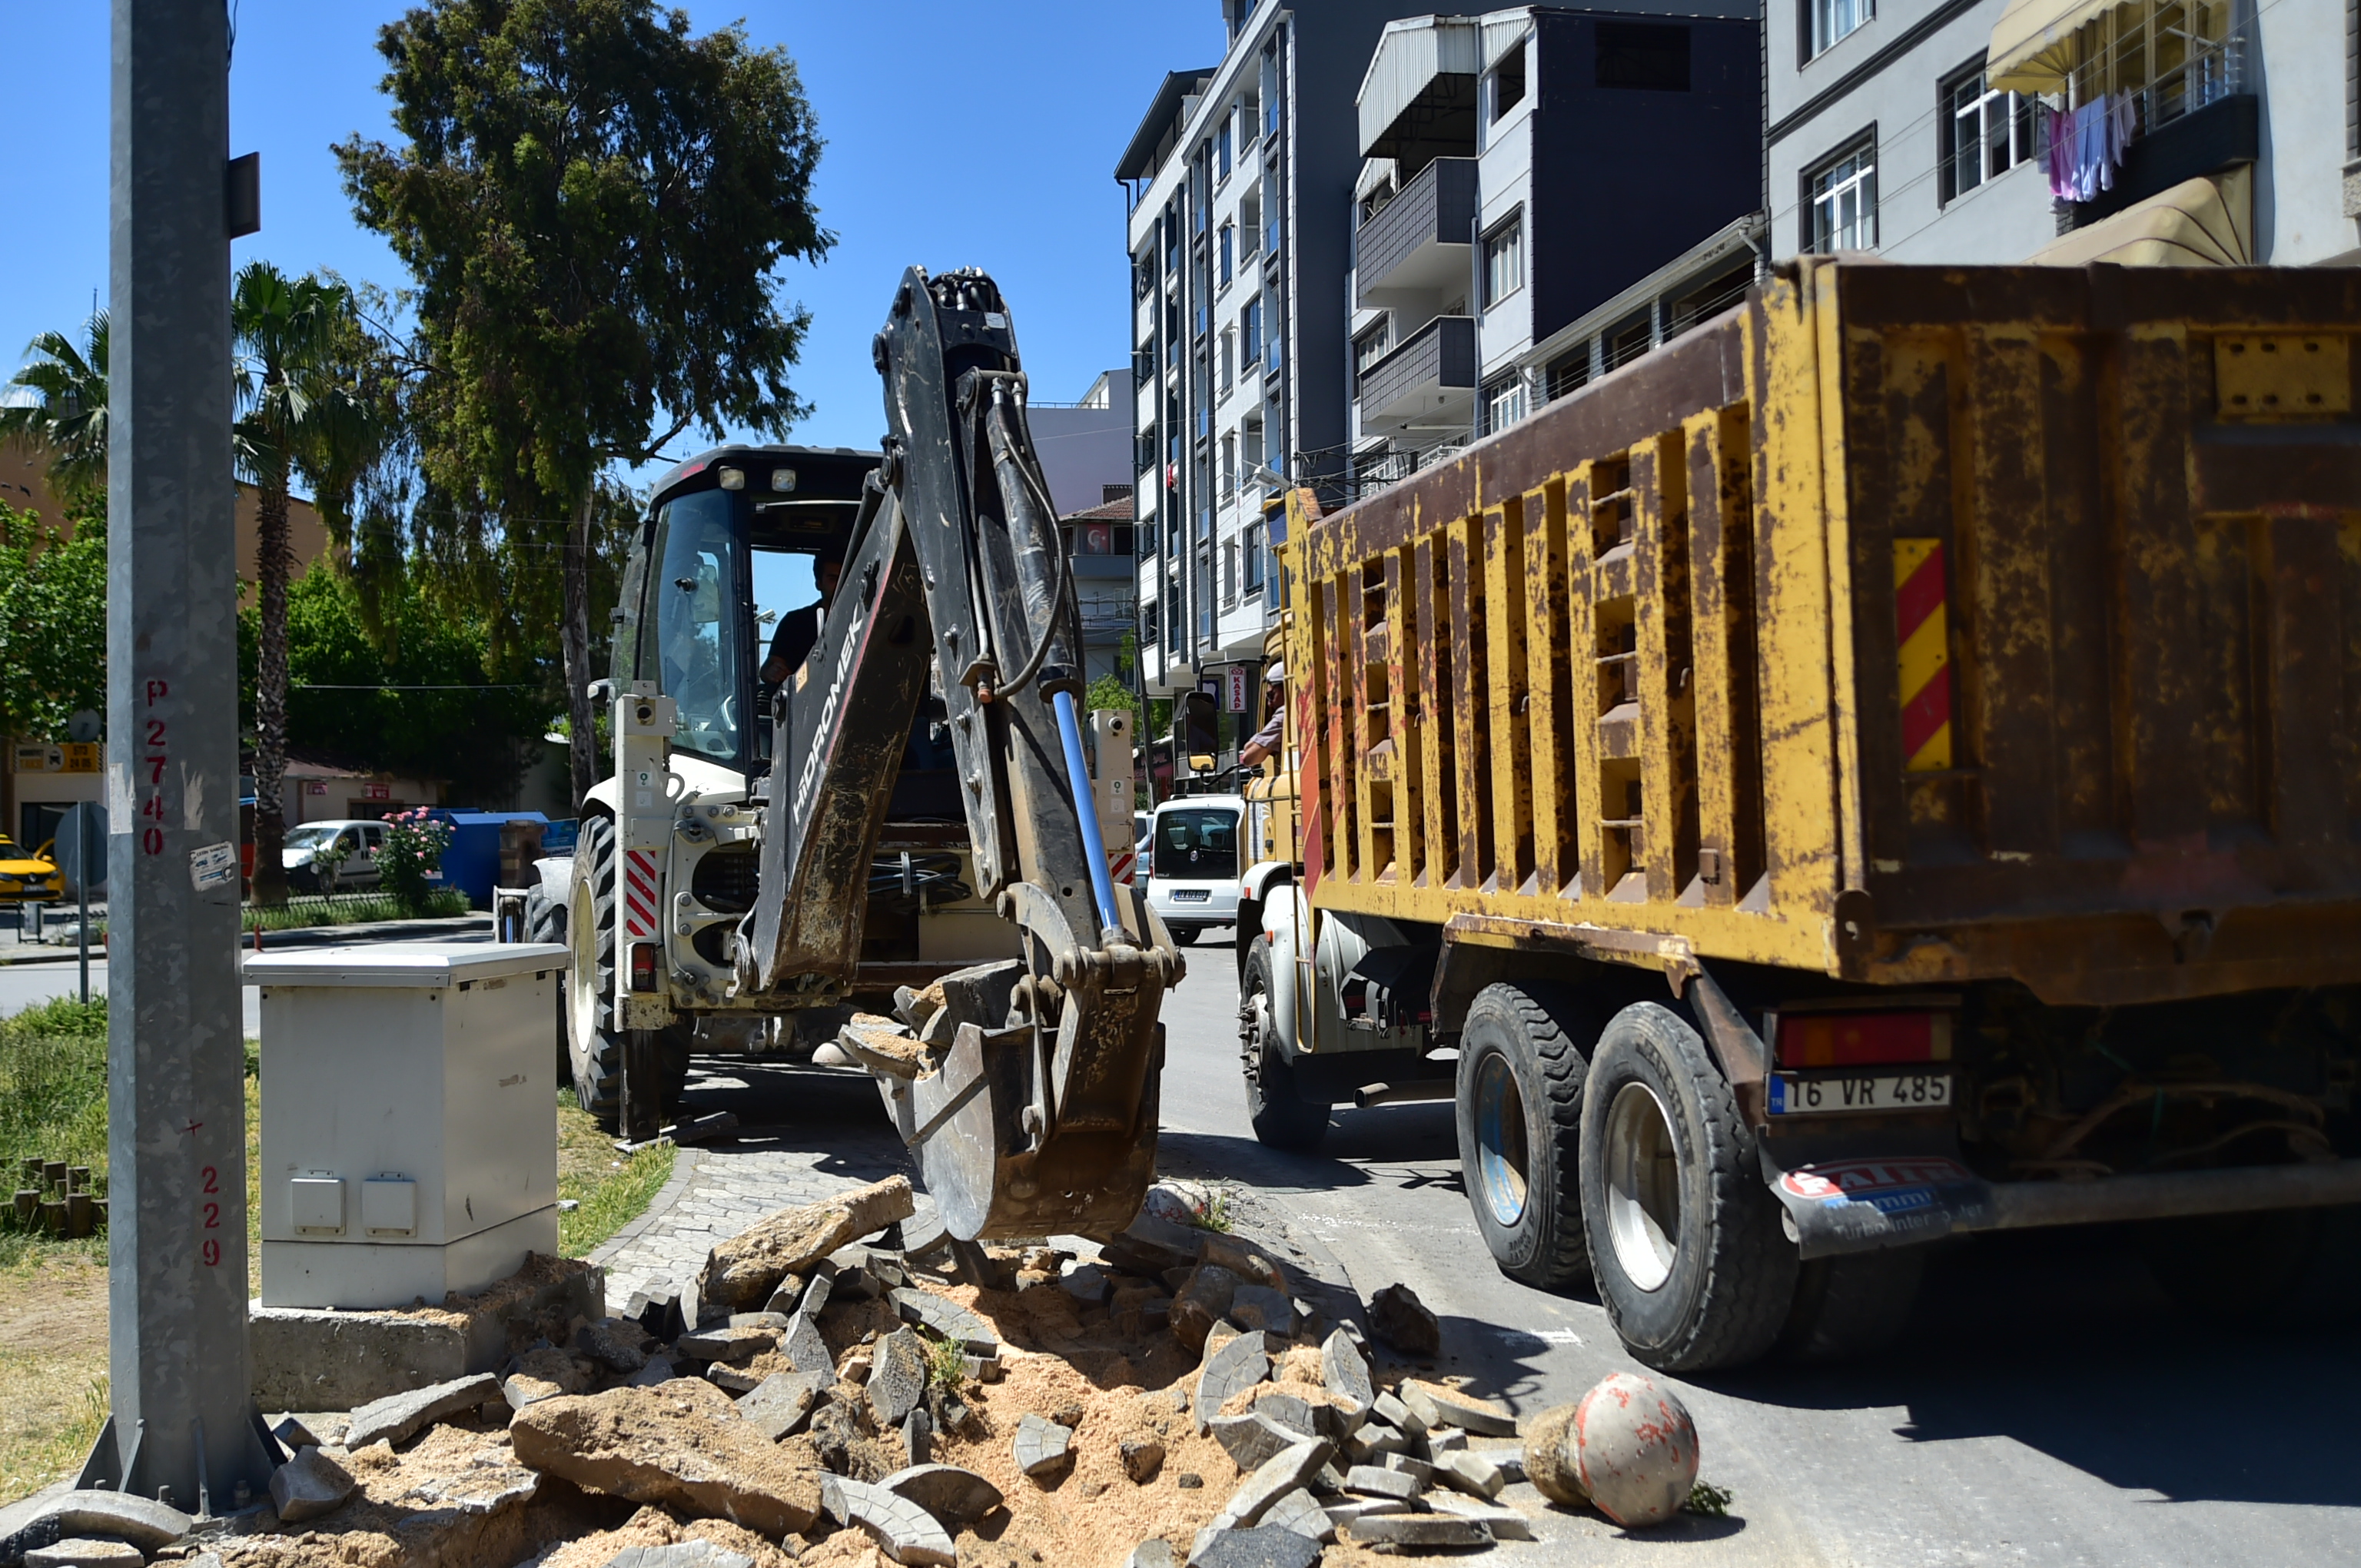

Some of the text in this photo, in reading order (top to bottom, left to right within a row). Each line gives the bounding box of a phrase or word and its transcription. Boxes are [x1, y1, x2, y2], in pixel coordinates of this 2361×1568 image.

[1233, 676, 1241, 709] KASAP
[1771, 1098, 1783, 1107] TR
[1789, 1075, 1945, 1107] 16 VR 485
[201, 1166, 221, 1267] 229
